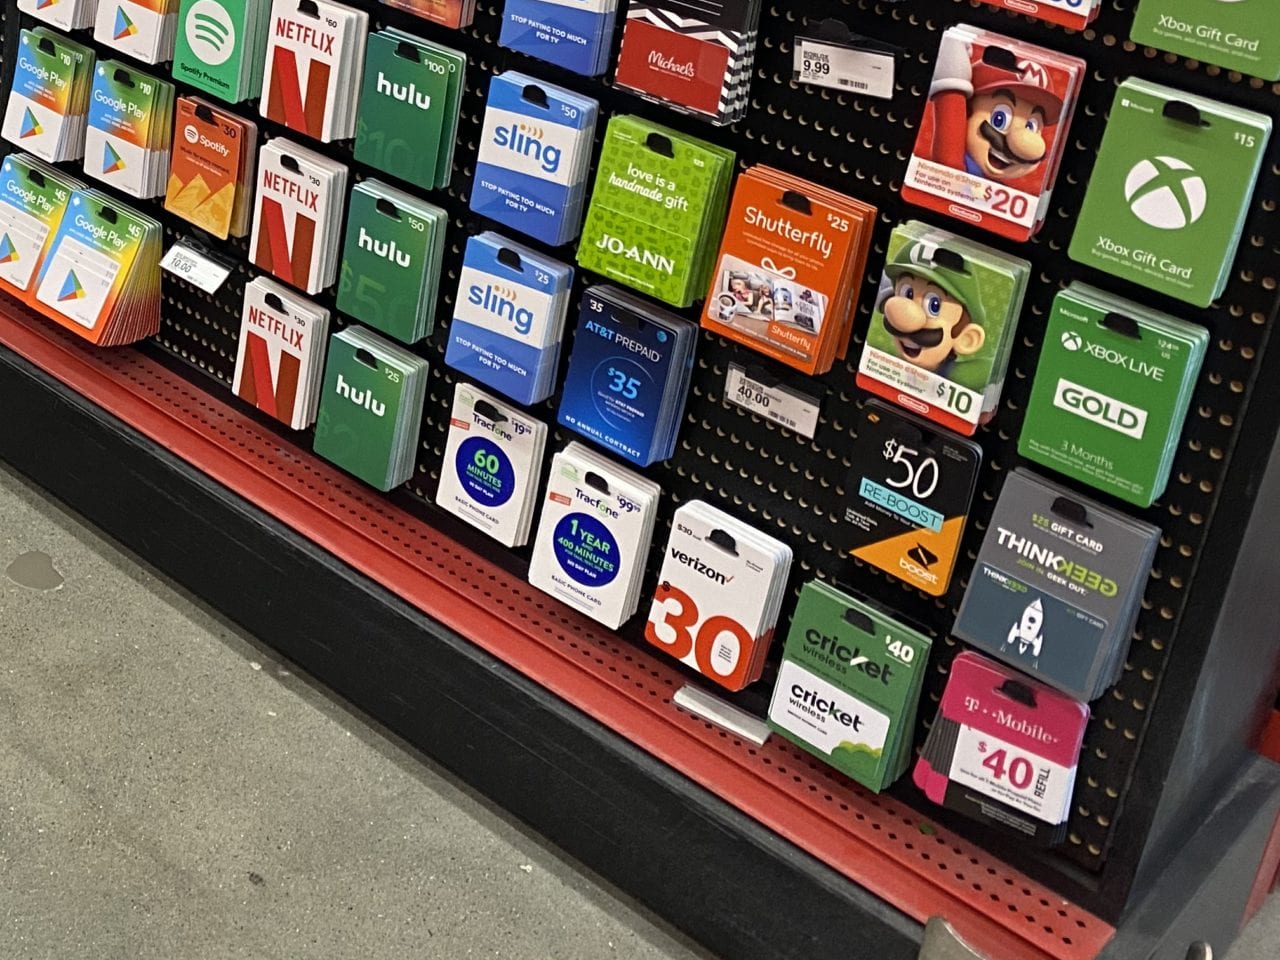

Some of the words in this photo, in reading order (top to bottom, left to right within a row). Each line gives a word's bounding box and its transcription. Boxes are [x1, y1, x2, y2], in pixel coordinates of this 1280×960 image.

[511, 14, 527, 26] STOP
[527, 18, 551, 35] PAYING
[551, 27, 566, 38] TOO
[566, 32, 587, 46] MUCH
[535, 31, 550, 41] FOR
[549, 34, 560, 44] TV
[1158, 13, 1194, 34] Xbox
[1196, 26, 1222, 43] Gift
[1224, 35, 1260, 53] Card
[424, 58, 446, 75] $100
[648, 50, 695, 78] Michaels
[803, 59, 830, 75] 9.99
[376, 71, 431, 110] hulu
[1233, 131, 1256, 148] $15
[627, 162, 654, 182] love
[655, 171, 666, 186] is
[667, 180, 676, 191] a
[608, 173, 664, 202] handmade
[664, 192, 689, 213] gift
[983, 185, 1029, 220] $20
[744, 206, 833, 258] Shutterfly
[826, 213, 849, 232] $25
[171, 257, 192, 274] 10.00
[584, 319, 615, 341] AT&T
[615, 332, 661, 363] PREPAID
[1083, 340, 1127, 368] XBOX
[1127, 357, 1165, 382] LIVE
[607, 366, 642, 400] $35
[737, 385, 770, 407] 40.00
[935, 381, 973, 415] $10
[1061, 387, 1140, 433] GOLD
[472, 412, 513, 442] Tracfone
[576, 419, 604, 438] ANNUAL
[603, 433, 641, 458] CONTRACT
[467, 464, 503, 489] MINUTES
[474, 449, 500, 474] 60
[882, 438, 939, 499] $50
[862, 481, 942, 529] RE-BOOST
[1051, 522, 1074, 539] GIFT
[1075, 533, 1104, 553] CARD
[670, 547, 726, 586] verizon
[802, 644, 848, 675] wireless
[805, 627, 896, 686] cricket
[885, 634, 915, 663] $40
[977, 741, 1035, 790] $40
[1033, 767, 1051, 798] REFILL
